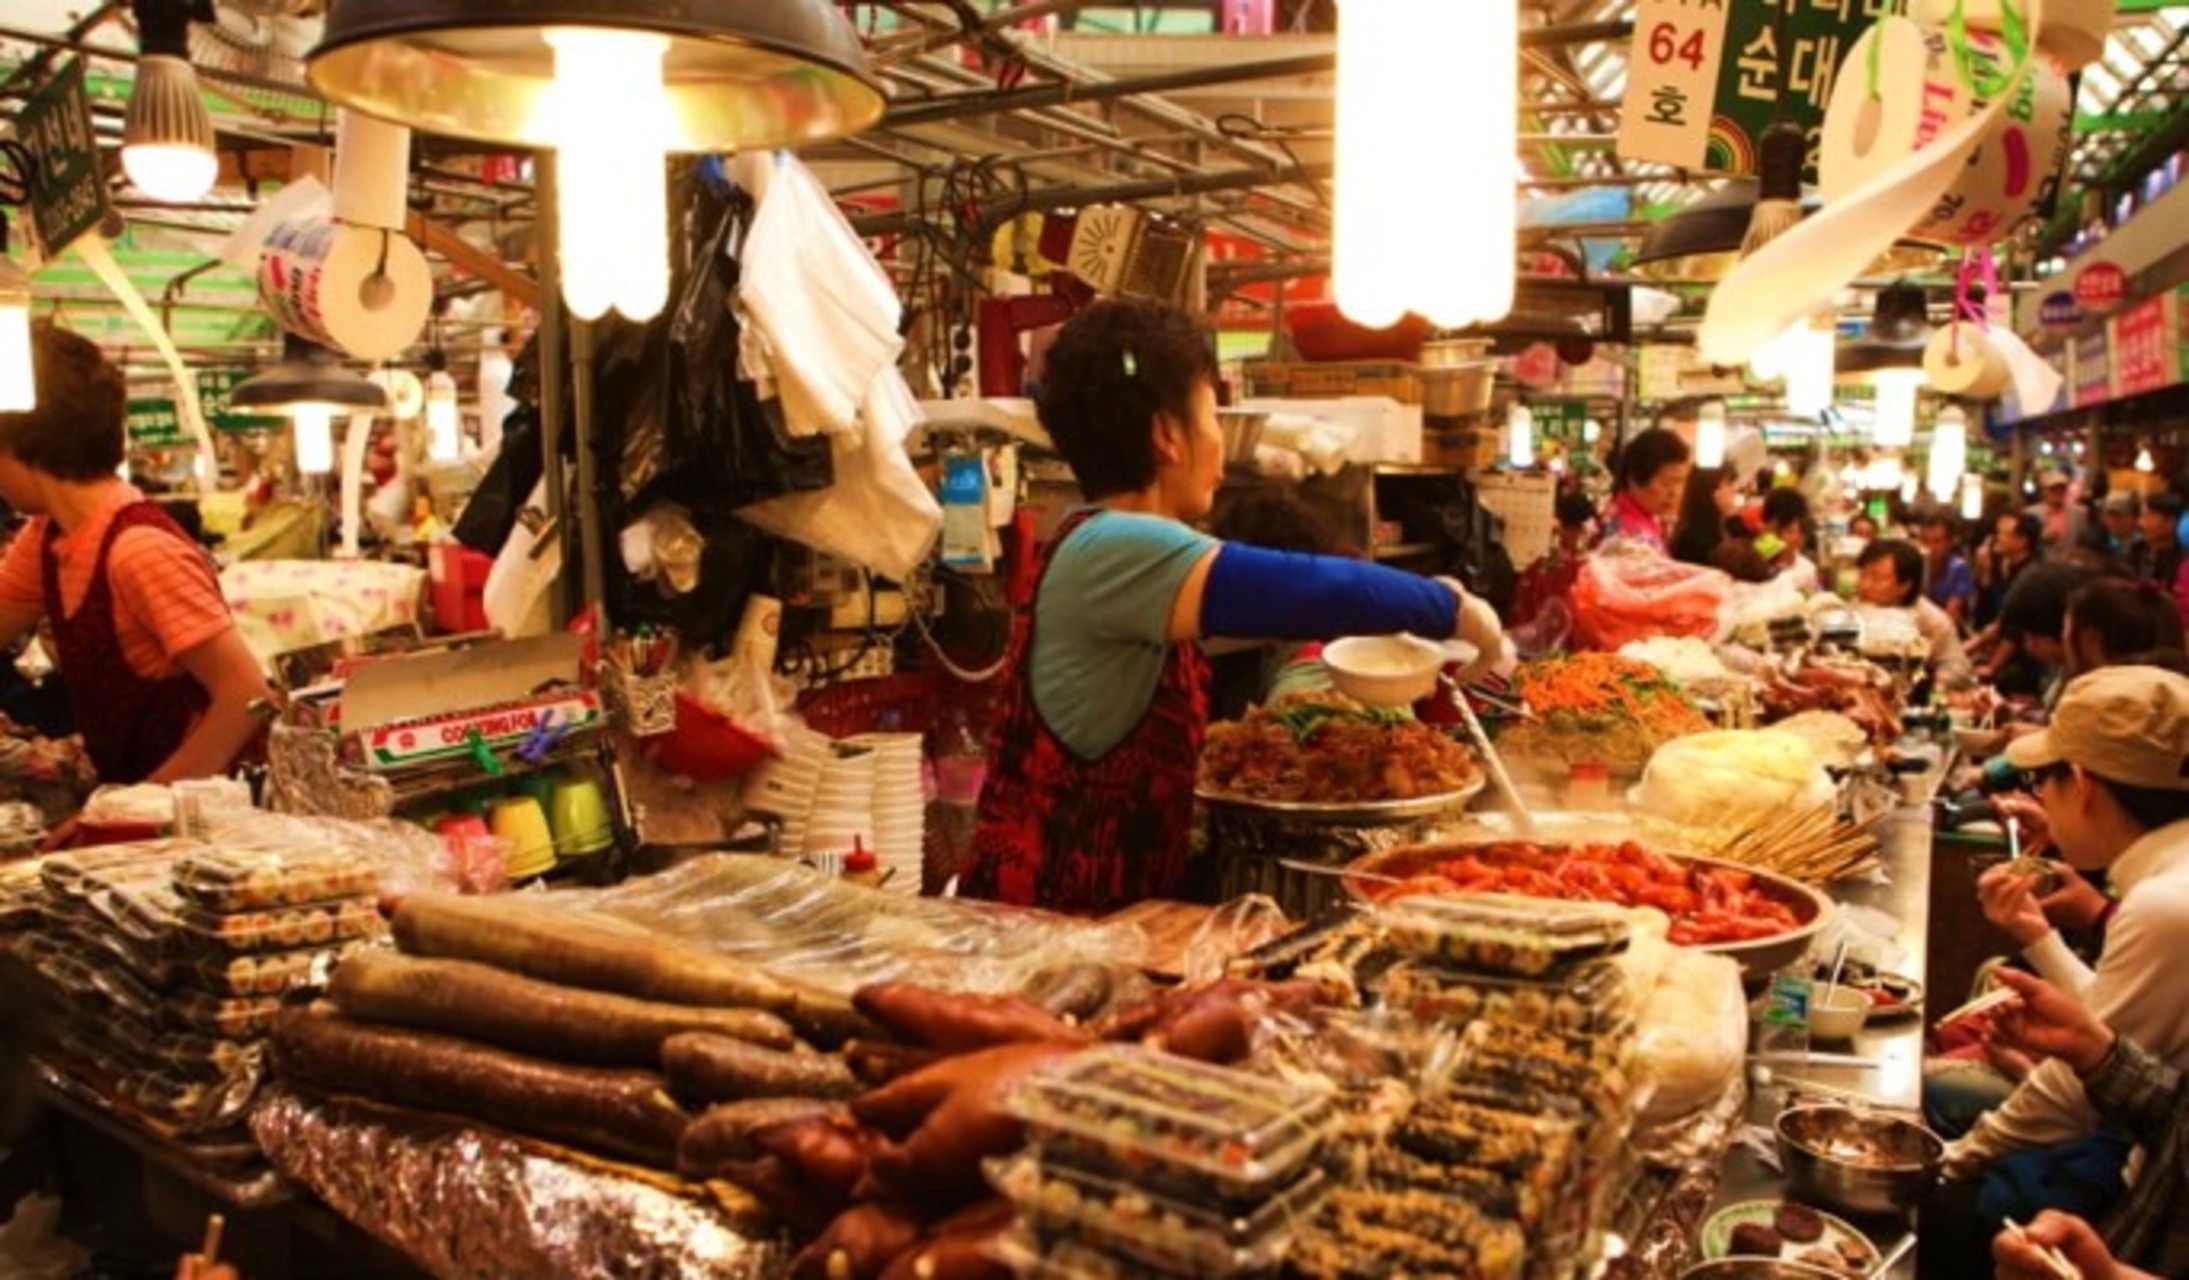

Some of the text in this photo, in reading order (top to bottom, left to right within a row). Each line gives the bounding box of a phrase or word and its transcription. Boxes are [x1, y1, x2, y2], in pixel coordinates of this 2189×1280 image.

[1649, 22, 1704, 70] 64
[1737, 25, 1839, 109] 순대
[1644, 85, 1688, 126] 호
